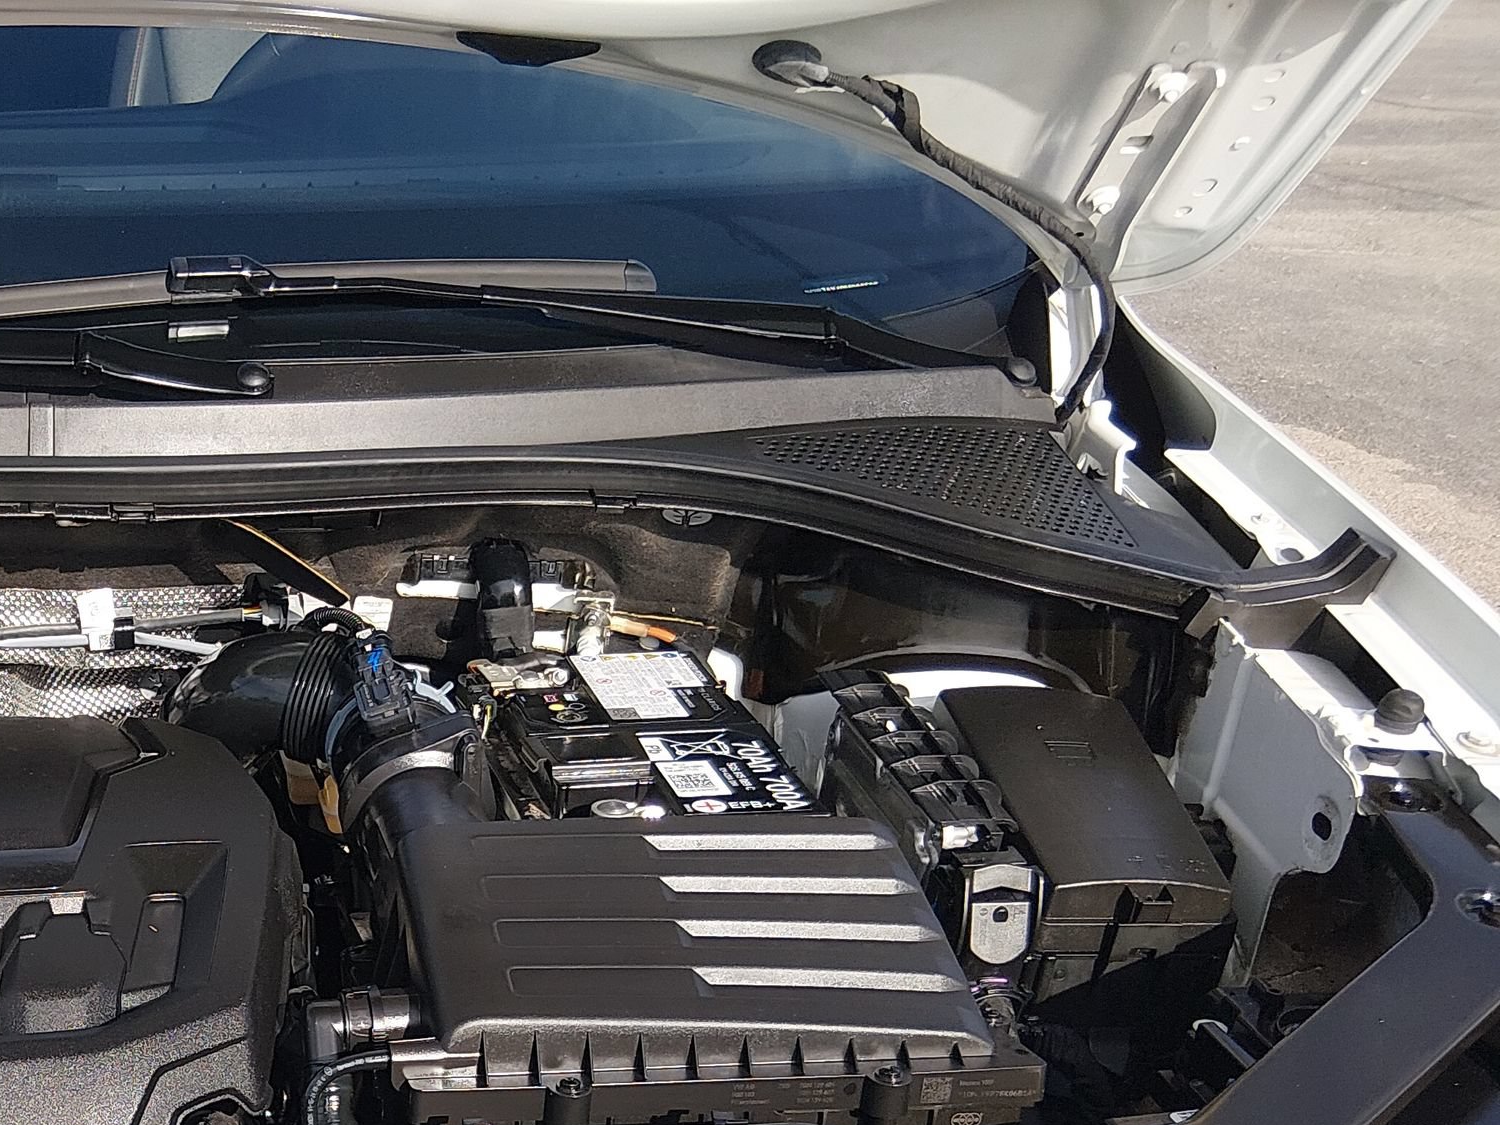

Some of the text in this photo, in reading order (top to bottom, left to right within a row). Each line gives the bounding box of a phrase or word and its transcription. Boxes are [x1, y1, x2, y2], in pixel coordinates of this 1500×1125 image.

[731, 740, 778, 774] 70Ah
[759, 775, 809, 811] 700A
[727, 800, 775, 810] EFB+
